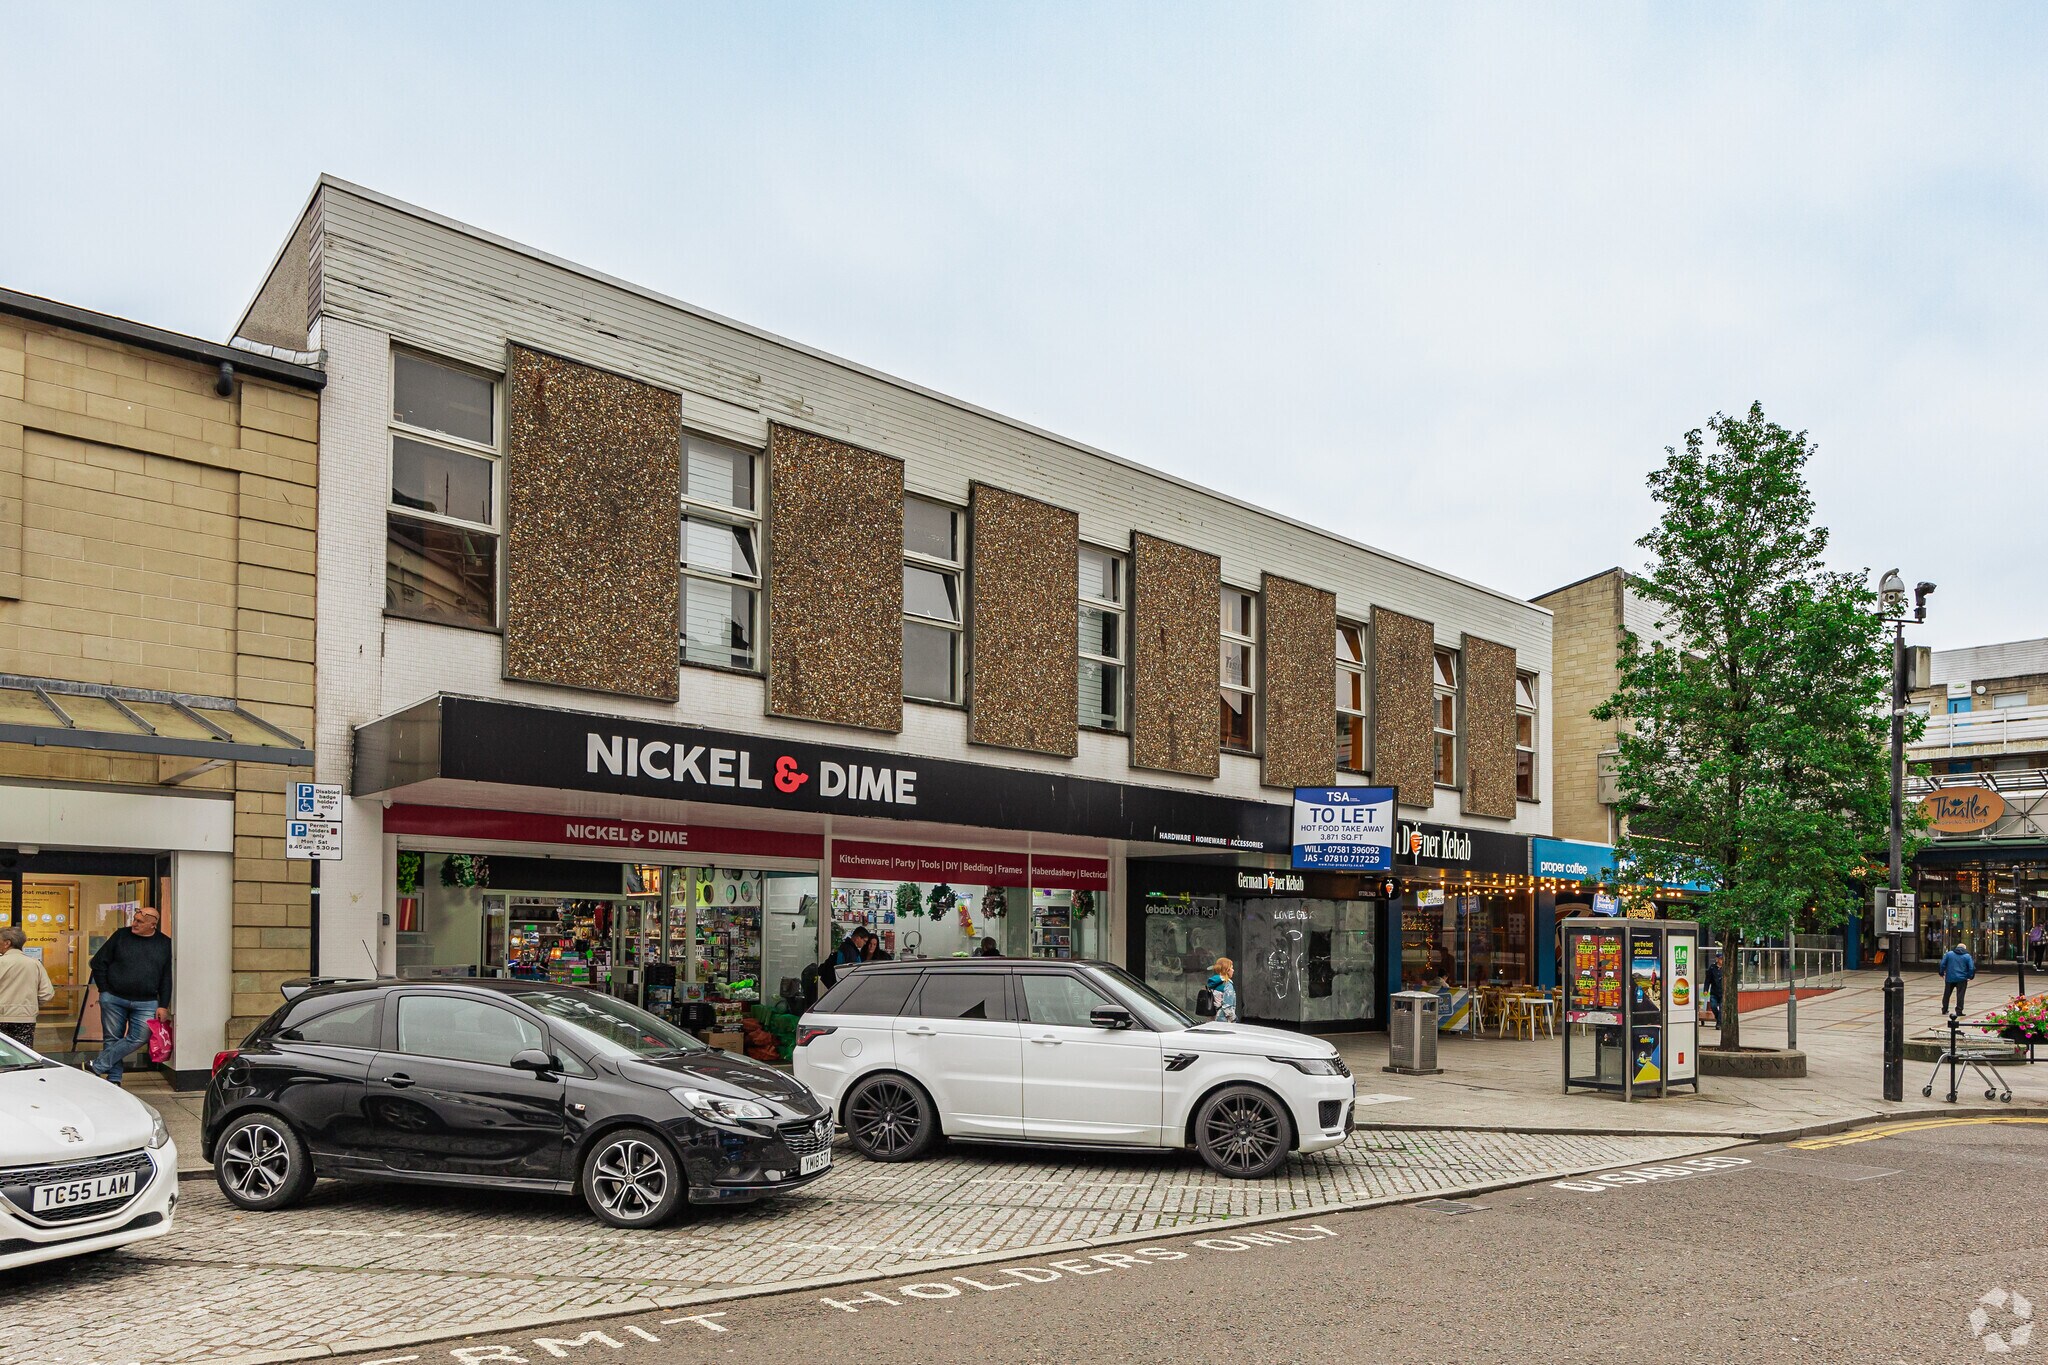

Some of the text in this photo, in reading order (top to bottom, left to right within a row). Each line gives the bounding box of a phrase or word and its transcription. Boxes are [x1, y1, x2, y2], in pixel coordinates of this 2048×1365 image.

[586, 732, 917, 805] NICKEL & DIME
[302, 786, 312, 797] P
[1326, 791, 1350, 802] TSA
[1930, 793, 1990, 820] Thistles
[1310, 808, 1377, 823] TO LET
[294, 825, 305, 836] P
[565, 823, 689, 846] NICKEL & DIME
[1159, 832, 1264, 849] HARDWARE HOMEWARE ACCESSORIES
[1441, 829, 1472, 861] Kebab
[1304, 845, 1322, 853] WILL
[1327, 846, 1350, 854] 07581
[1352, 846, 1379, 854] 396092
[839, 854, 1023, 875] Kitchenware Party Tools DIY Bedding Frames
[1304, 854, 1318, 862] JAS
[1324, 855, 1349, 863] 07810
[1350, 855, 1380, 864] 717229
[1031, 866, 1108, 879] Haberdashery Electrical
[1540, 860, 1588, 875] proper coffee
[1238, 872, 1263, 889] German
[1286, 875, 1304, 891] Kebab
[1177, 905, 1200, 916] Done
[1274, 910, 1296, 920] LOVE
[1549, 1156, 1752, 1193] DISABLED
[43, 1175, 130, 1207] TC55 LAM
[820, 1224, 1339, 1314] HOLDERS ONLY
